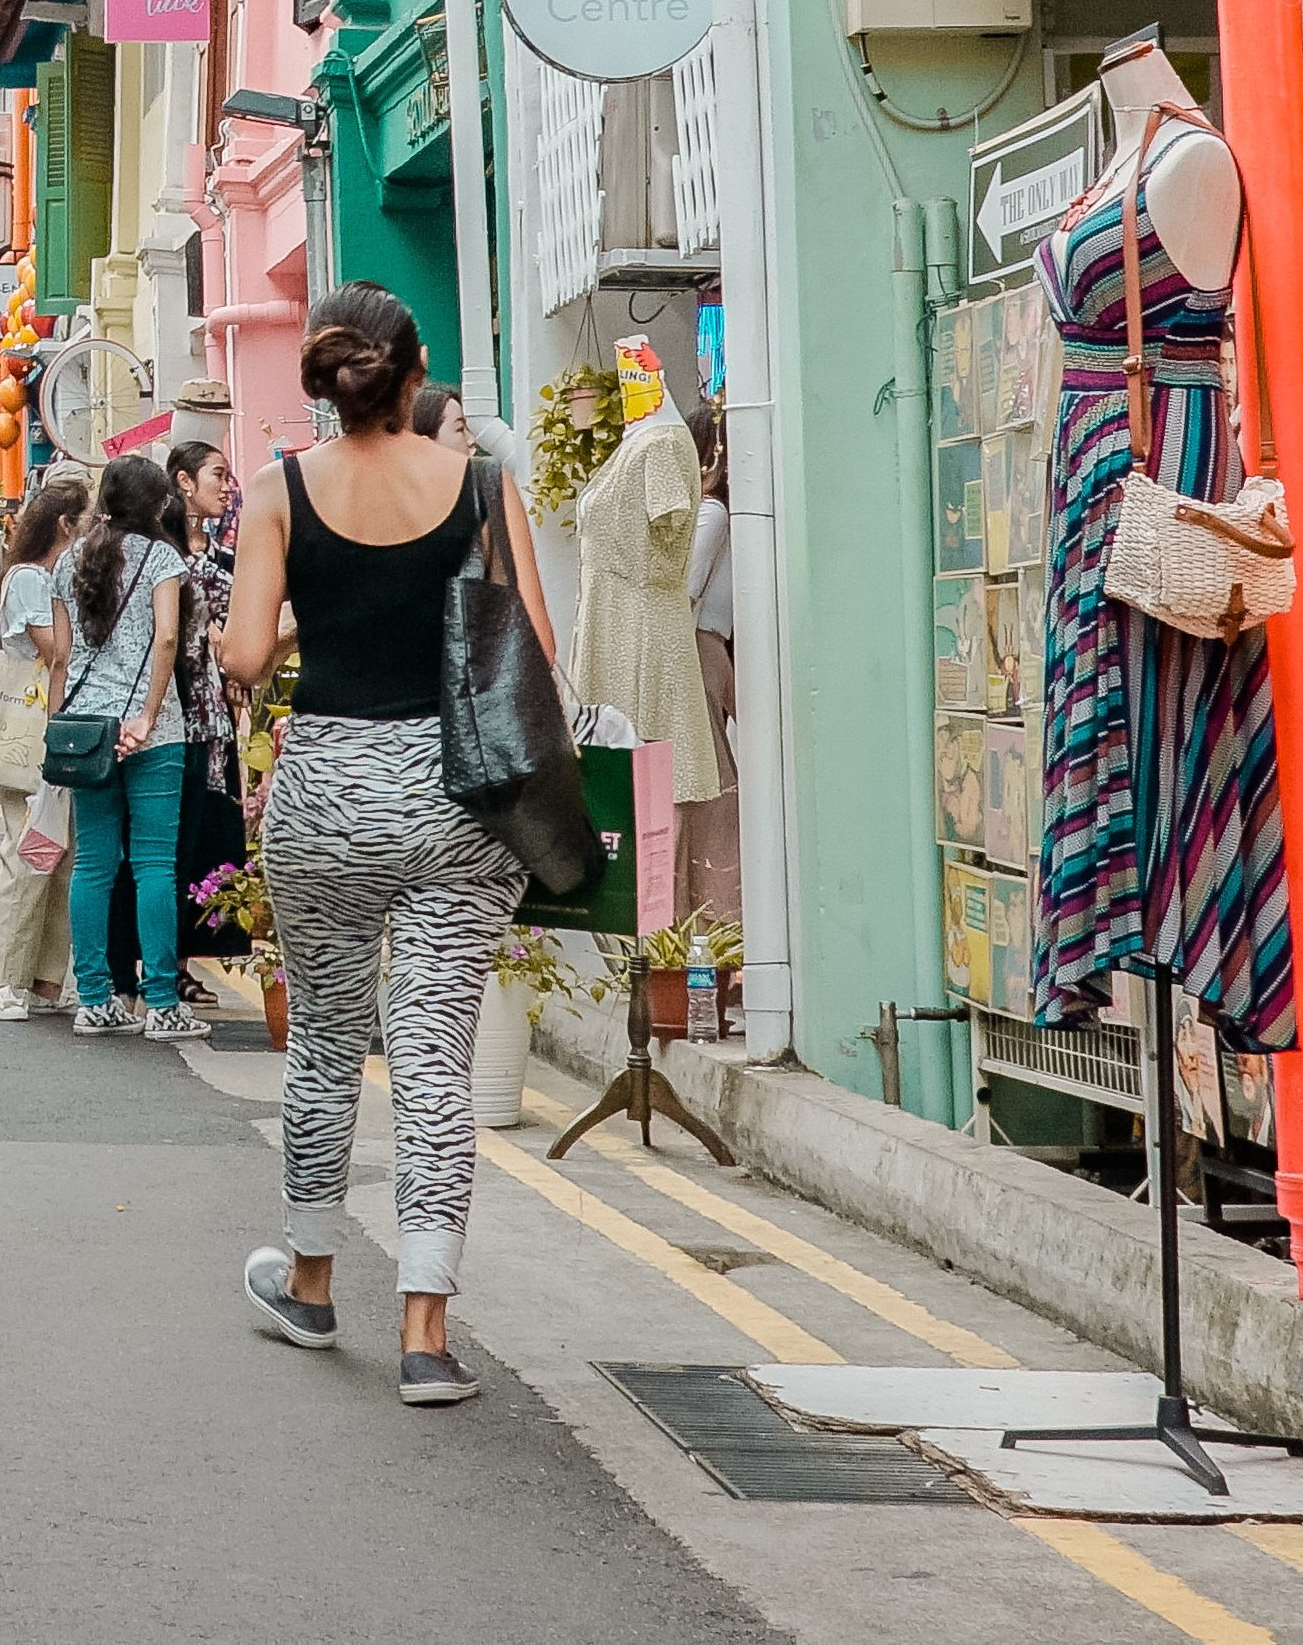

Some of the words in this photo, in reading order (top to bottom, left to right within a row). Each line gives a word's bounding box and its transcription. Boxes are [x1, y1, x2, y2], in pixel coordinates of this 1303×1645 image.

[1000, 188, 1025, 226] THE
[1028, 173, 1056, 215] ONLY
[1059, 162, 1081, 202] WAY
